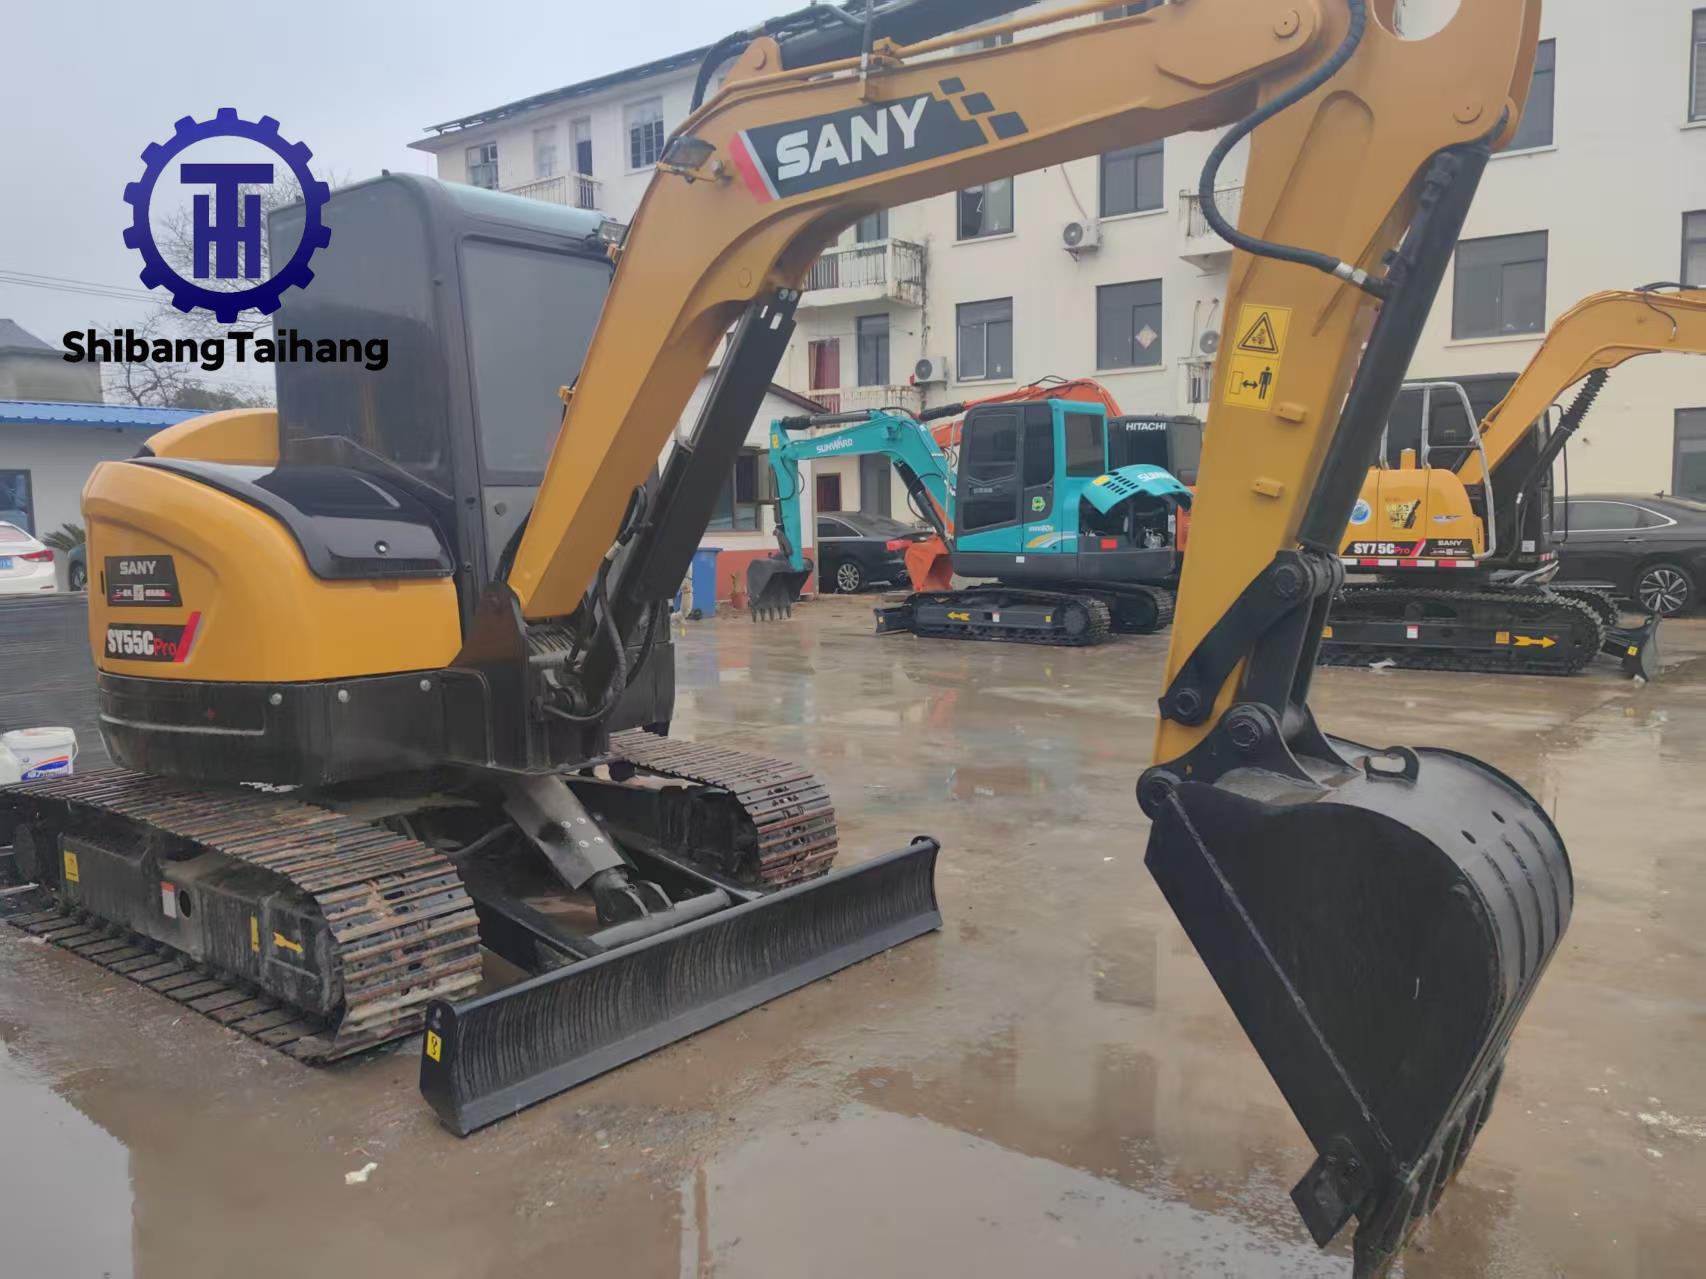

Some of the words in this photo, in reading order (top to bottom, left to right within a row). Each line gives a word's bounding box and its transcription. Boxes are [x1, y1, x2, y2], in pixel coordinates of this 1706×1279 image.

[776, 96, 929, 181] SANY
[1125, 422, 1167, 431] HITACHI
[119, 560, 157, 576] SANY
